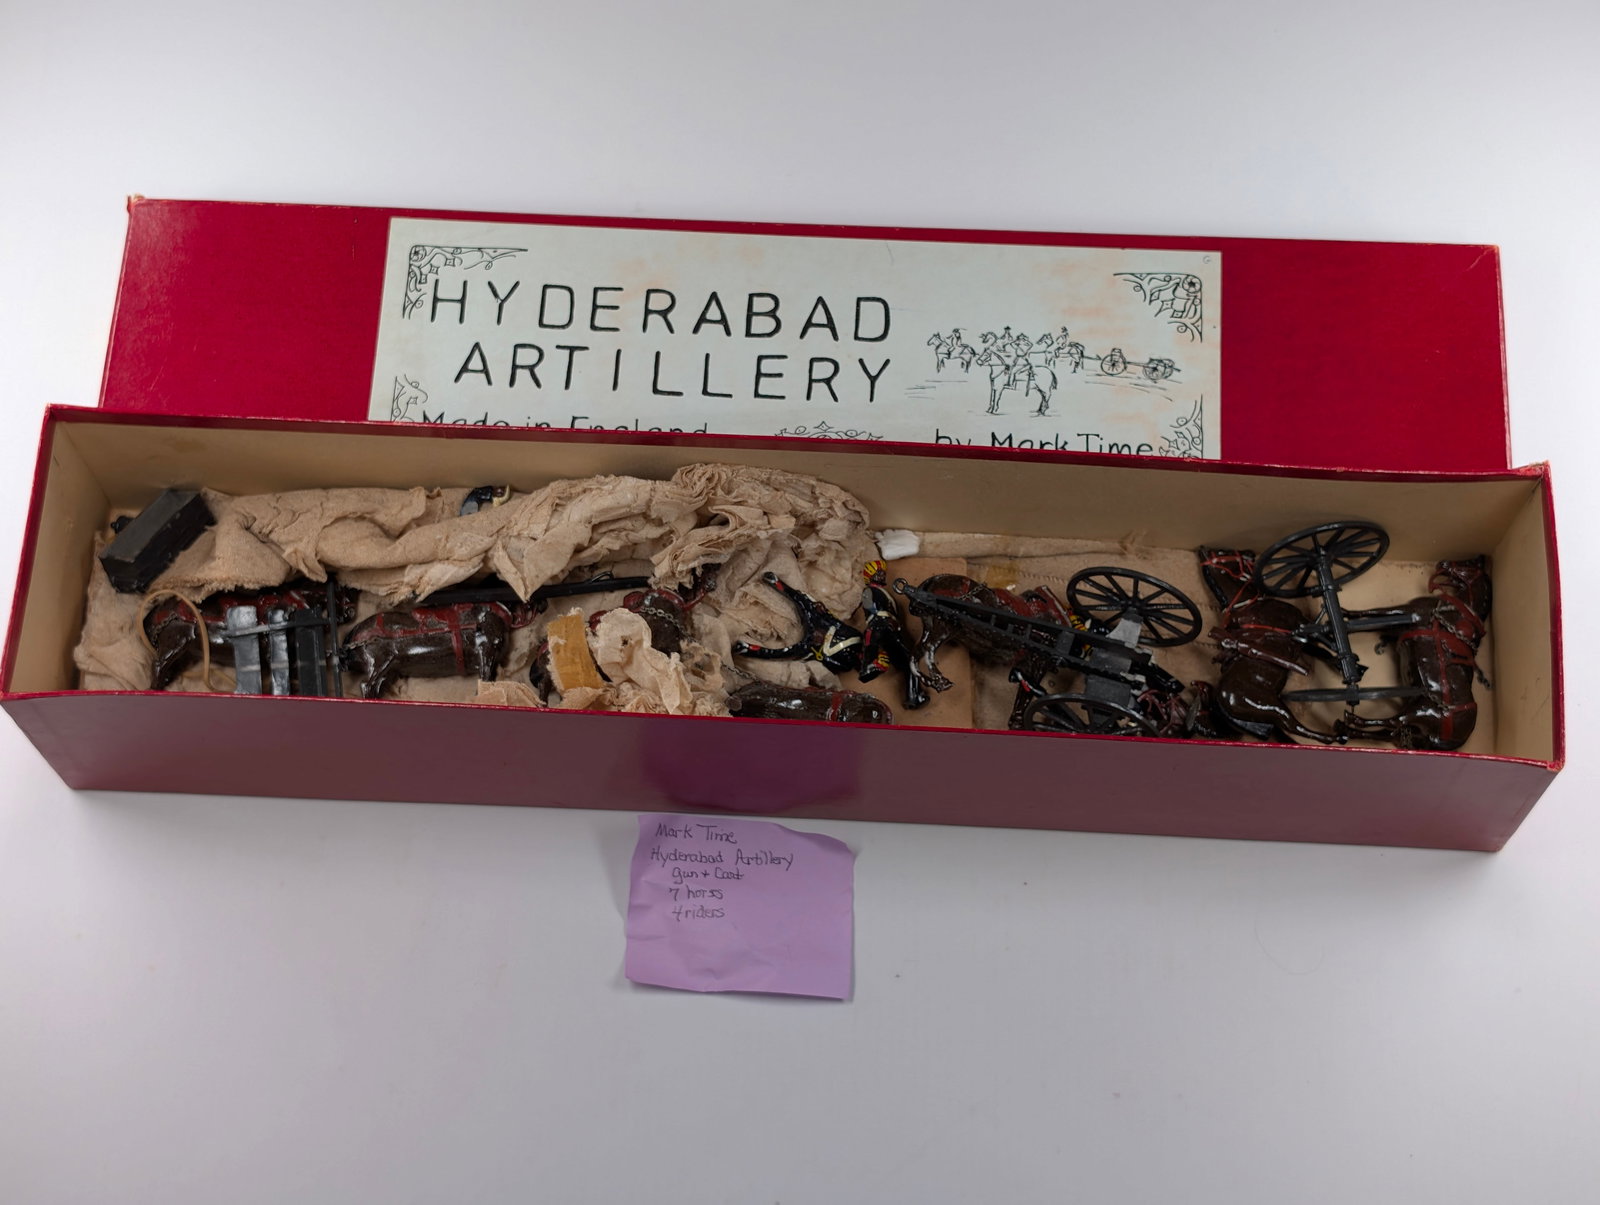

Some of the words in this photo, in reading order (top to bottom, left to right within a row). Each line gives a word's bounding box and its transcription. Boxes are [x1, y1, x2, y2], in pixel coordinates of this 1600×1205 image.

[430, 278, 891, 342] HYDERABAD
[453, 341, 891, 403] ARTILLERY
[1076, 433, 1154, 456] Time
[655, 822, 694, 839] Mark
[696, 823, 738, 844] Time
[650, 845, 724, 867] Hyderabad
[735, 848, 794, 871] Artillery
[668, 887, 680, 902] 7
